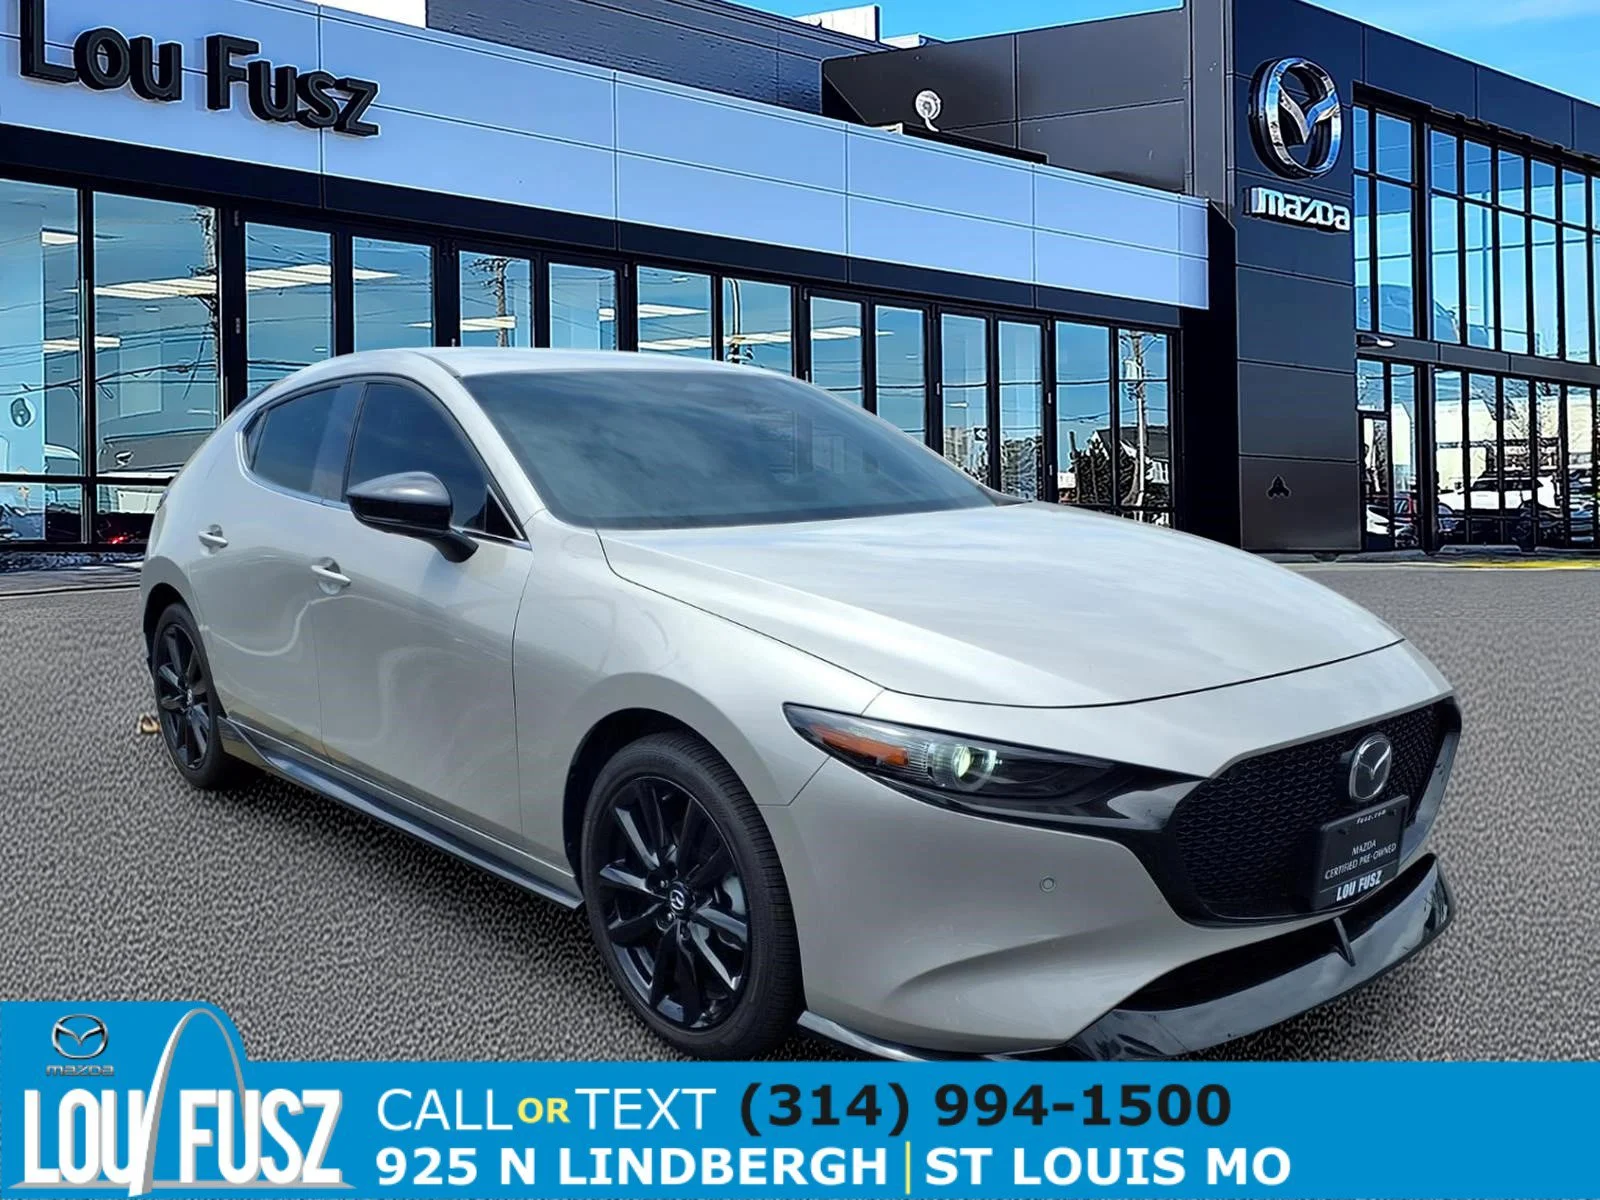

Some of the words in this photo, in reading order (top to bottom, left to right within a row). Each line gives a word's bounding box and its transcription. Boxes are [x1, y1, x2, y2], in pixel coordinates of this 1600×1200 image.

[20, 0, 182, 101] Lou
[207, 34, 380, 136] Fusz
[1250, 186, 1351, 232] mazda
[1324, 858, 1358, 880] CERTIFIED
[1359, 842, 1397, 867] PRE-OWNED
[1352, 839, 1377, 856] MAZDA
[1336, 880, 1357, 902] LOU
[1358, 870, 1384, 894] FUSZ
